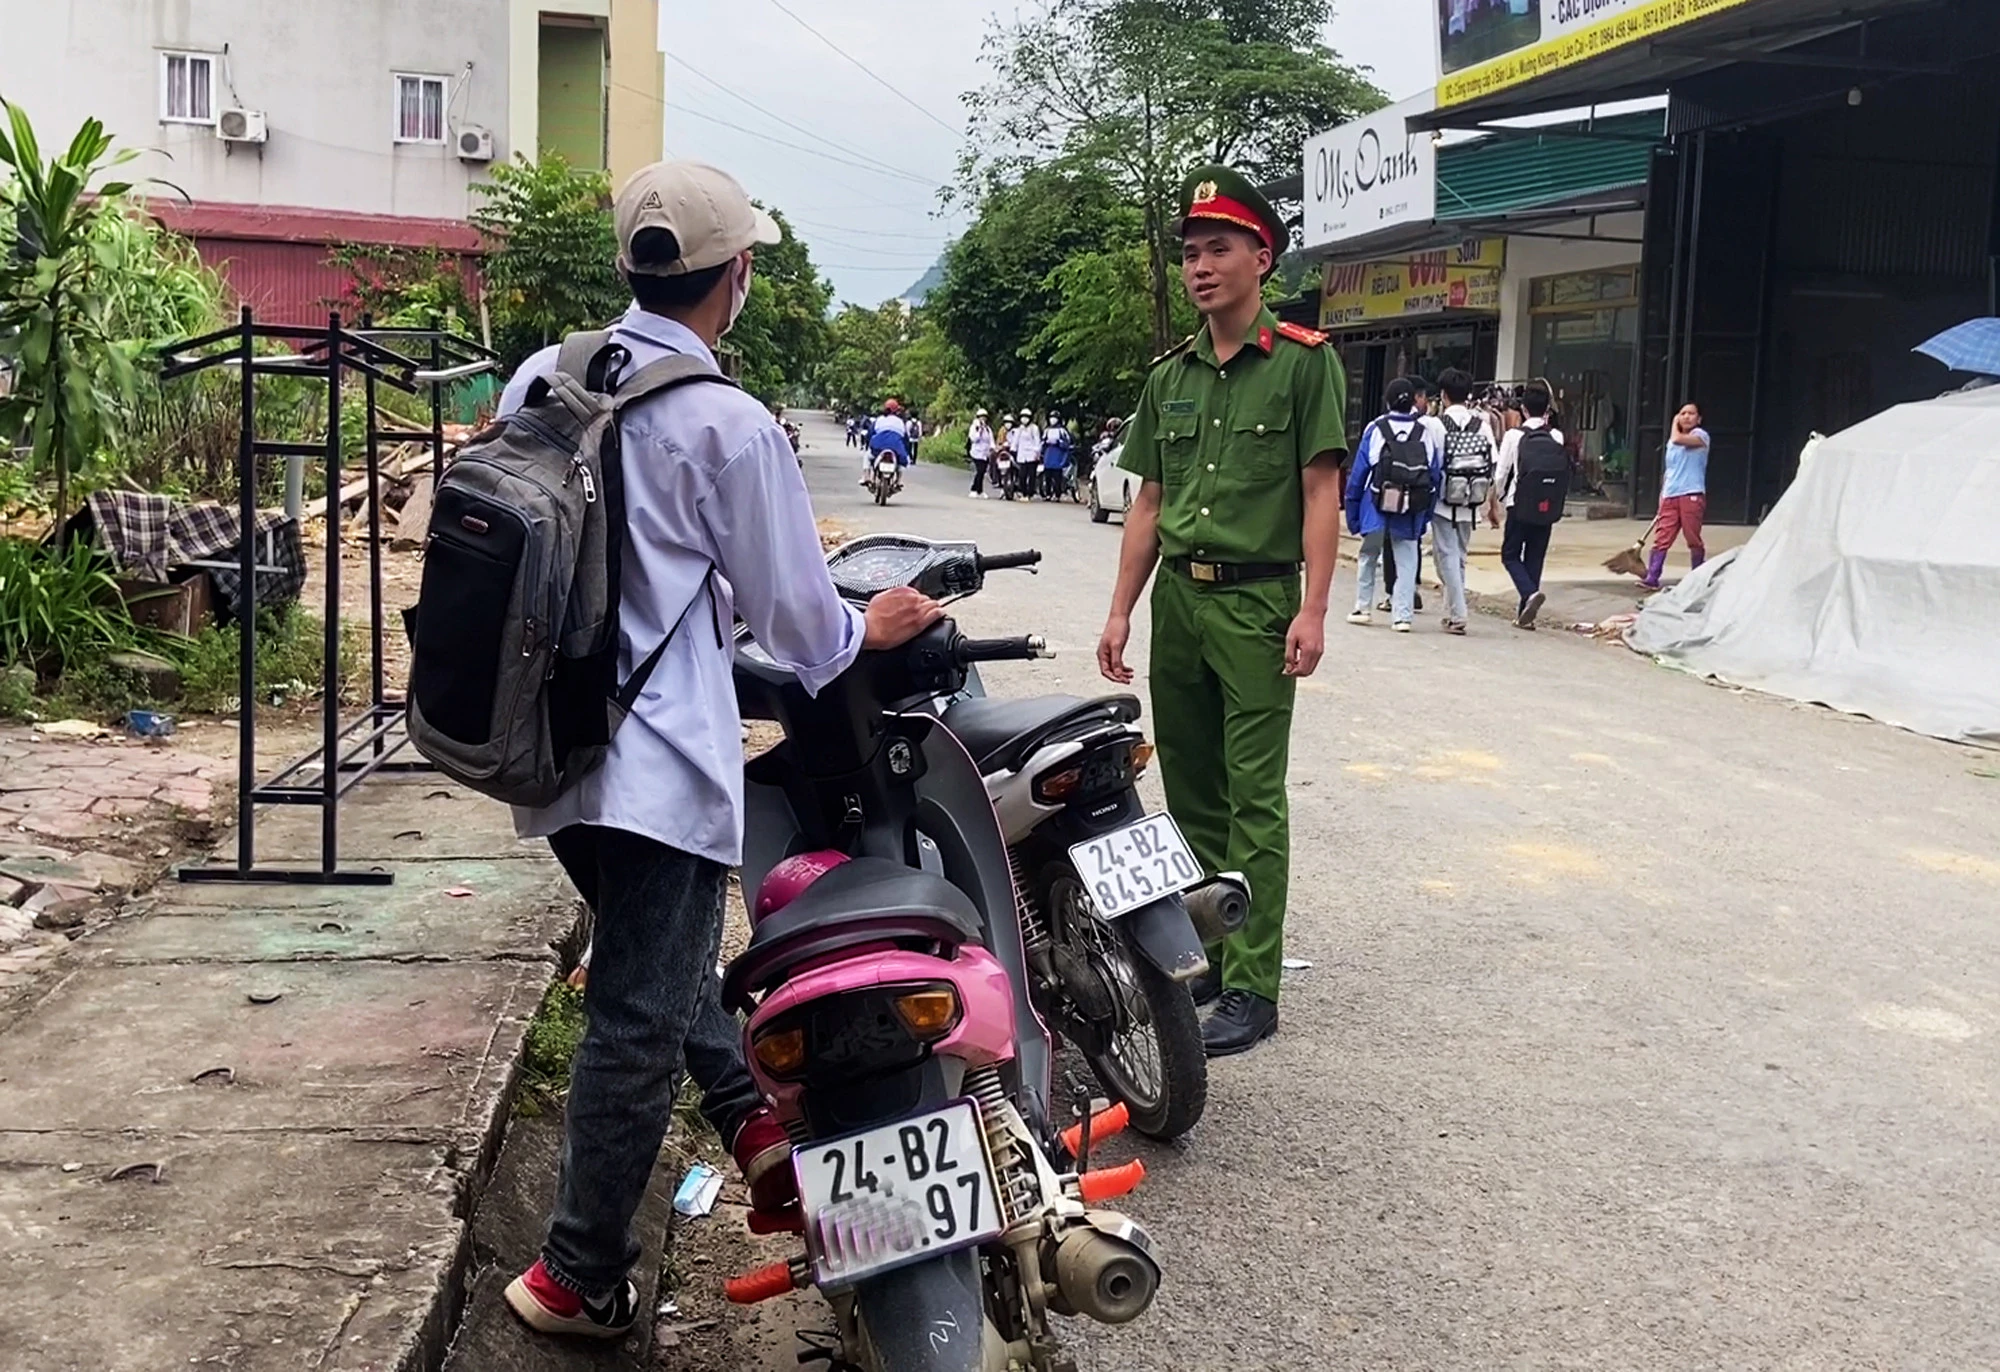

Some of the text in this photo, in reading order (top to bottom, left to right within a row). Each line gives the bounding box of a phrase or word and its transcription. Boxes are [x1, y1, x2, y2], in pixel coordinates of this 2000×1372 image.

[1089, 824, 1168, 875] 24-B2
[1095, 851, 1194, 910] 845.20
[822, 1118, 957, 1204] 24-B2
